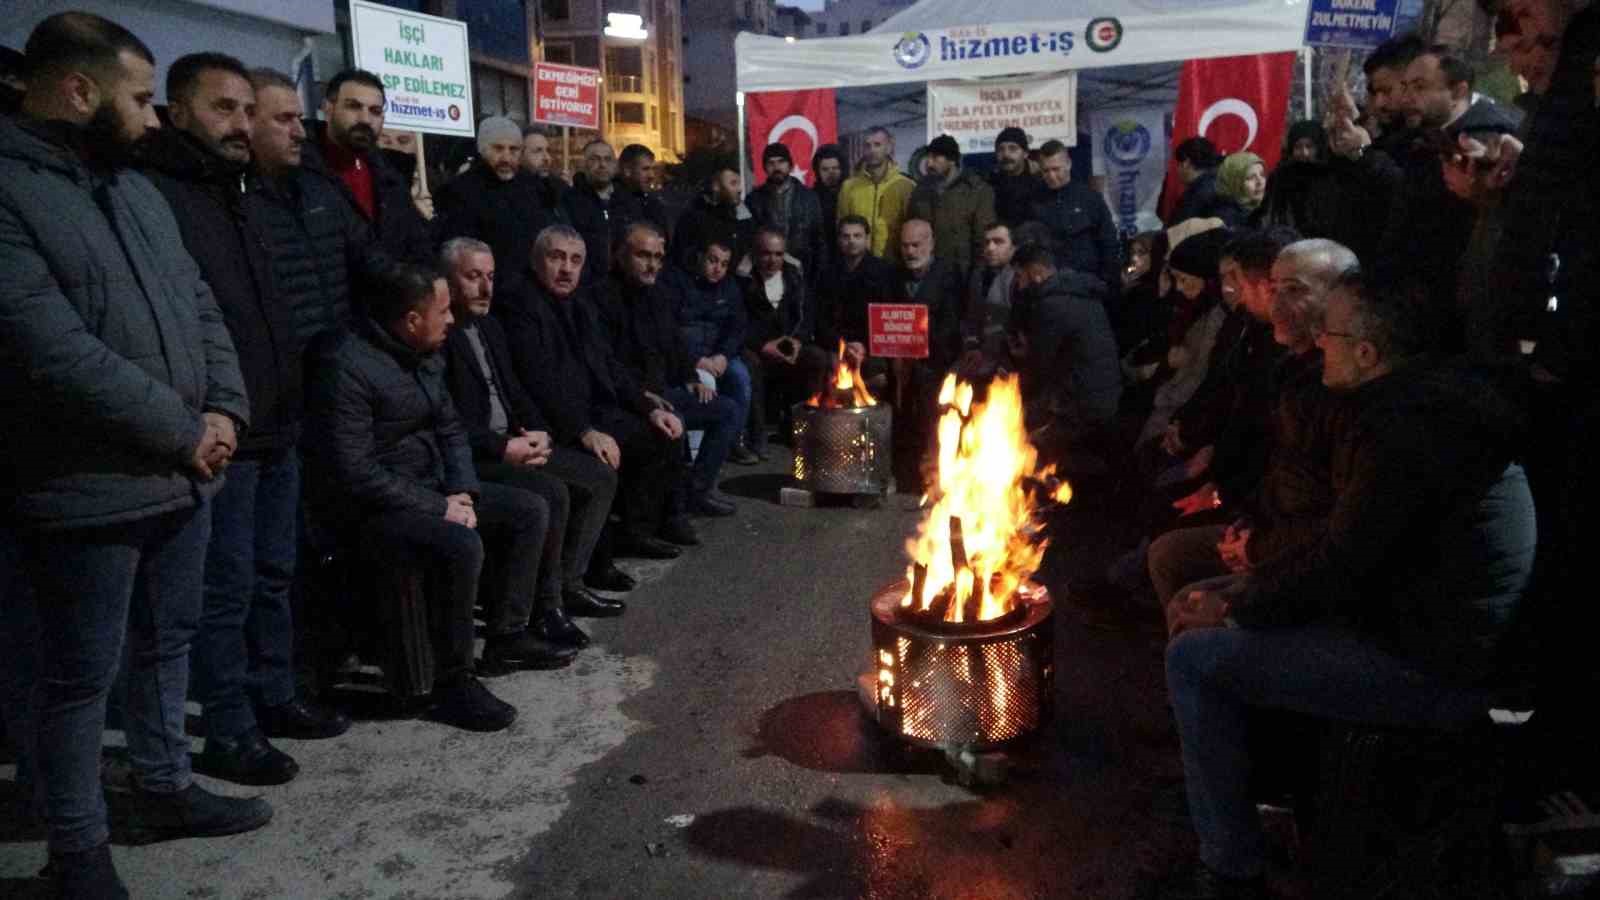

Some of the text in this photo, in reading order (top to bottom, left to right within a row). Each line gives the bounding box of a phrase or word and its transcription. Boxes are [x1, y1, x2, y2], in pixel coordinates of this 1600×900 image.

[1312, 11, 1391, 30] ZULMETMEYİN
[399, 19, 425, 46] İŞÇİ
[940, 31, 1074, 60] hizmet-iş
[383, 47, 444, 71] HAKLARI
[379, 73, 466, 99] SP EDİLEMEZ
[555, 84, 579, 99] GERİ
[391, 101, 447, 120] hizmet-iş
[541, 96, 593, 116] İSTİYORUZ
